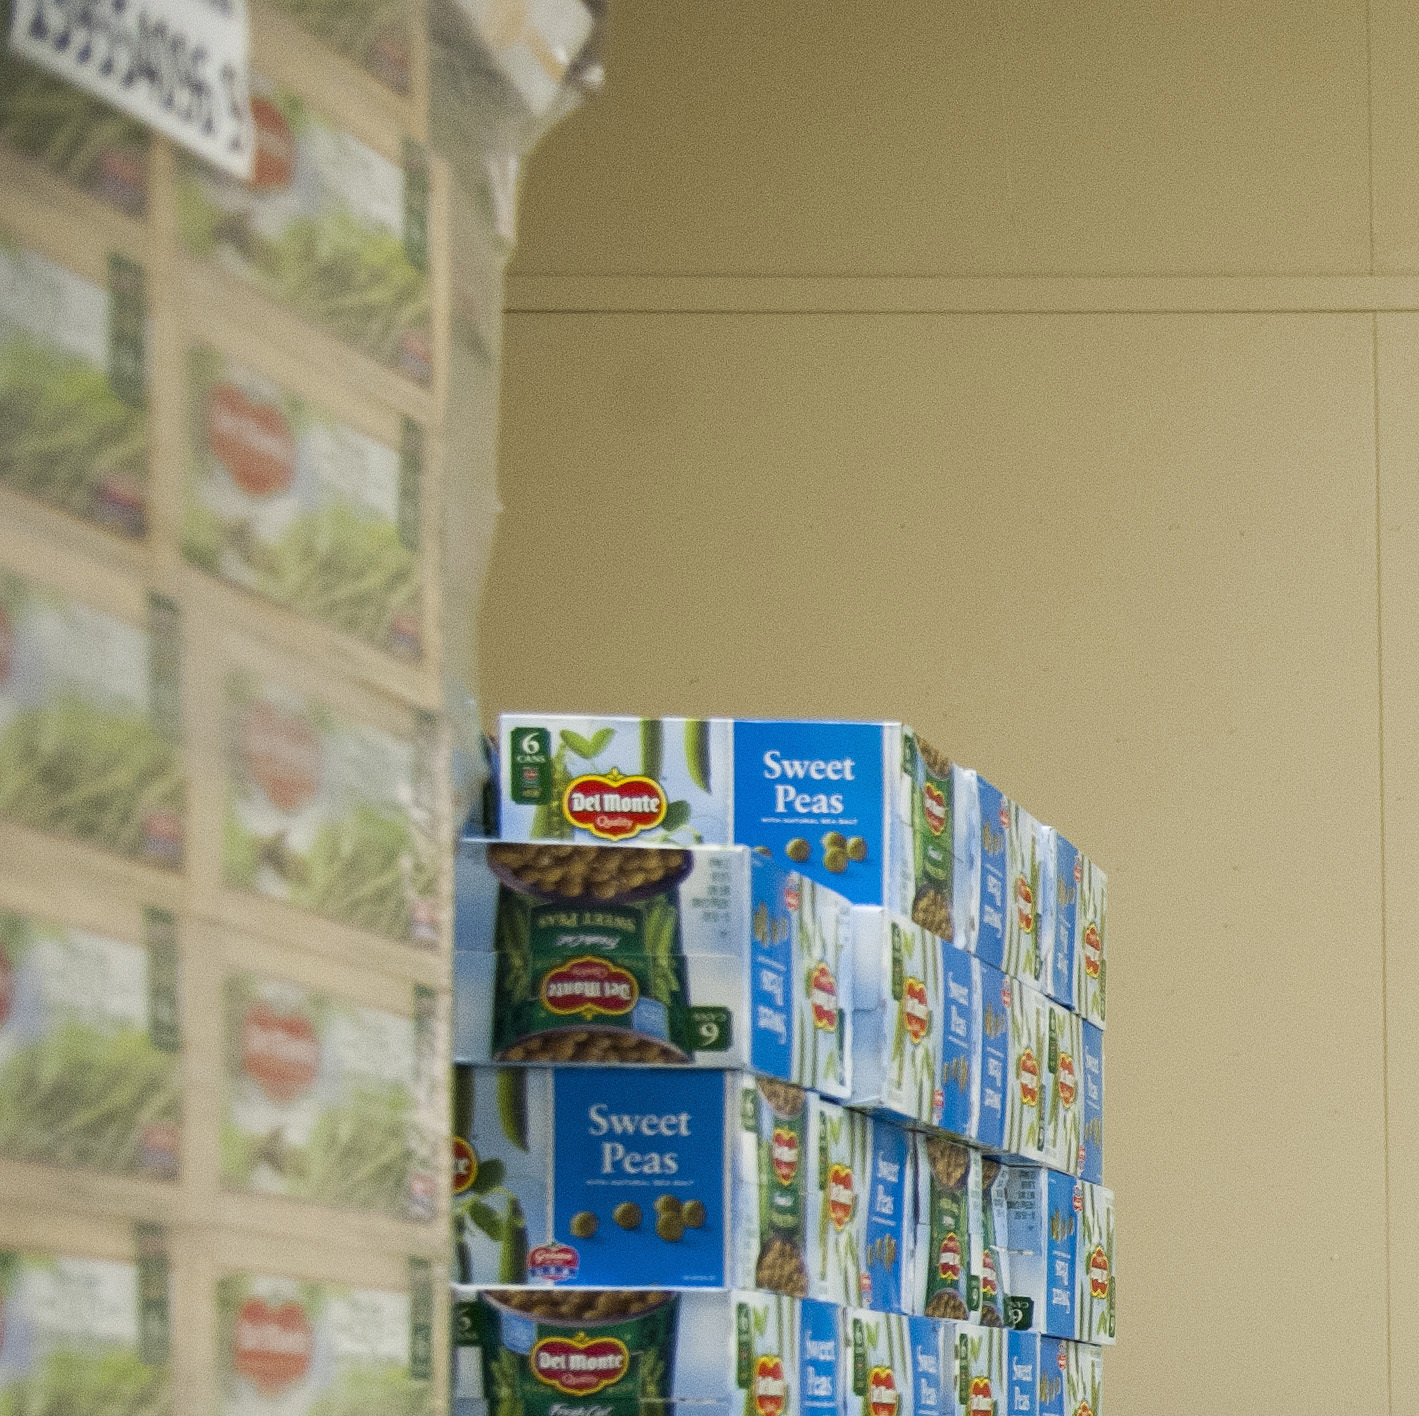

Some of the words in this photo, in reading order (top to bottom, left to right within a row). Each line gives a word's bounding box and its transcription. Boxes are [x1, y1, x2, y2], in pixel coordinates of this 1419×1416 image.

[521, 732, 540, 754] 6
[763, 749, 855, 781] Sweet
[572, 793, 601, 813] Del
[604, 793, 660, 814] Monte
[774, 785, 844, 815] Peas
[549, 981, 602, 998] Monte
[604, 983, 631, 1000] Del
[700, 1022, 719, 1046] 6
[588, 1103, 691, 1137] Sweet
[601, 1141, 678, 1175] Peas
[538, 1352, 566, 1369] Del
[570, 1352, 623, 1371] Monte
